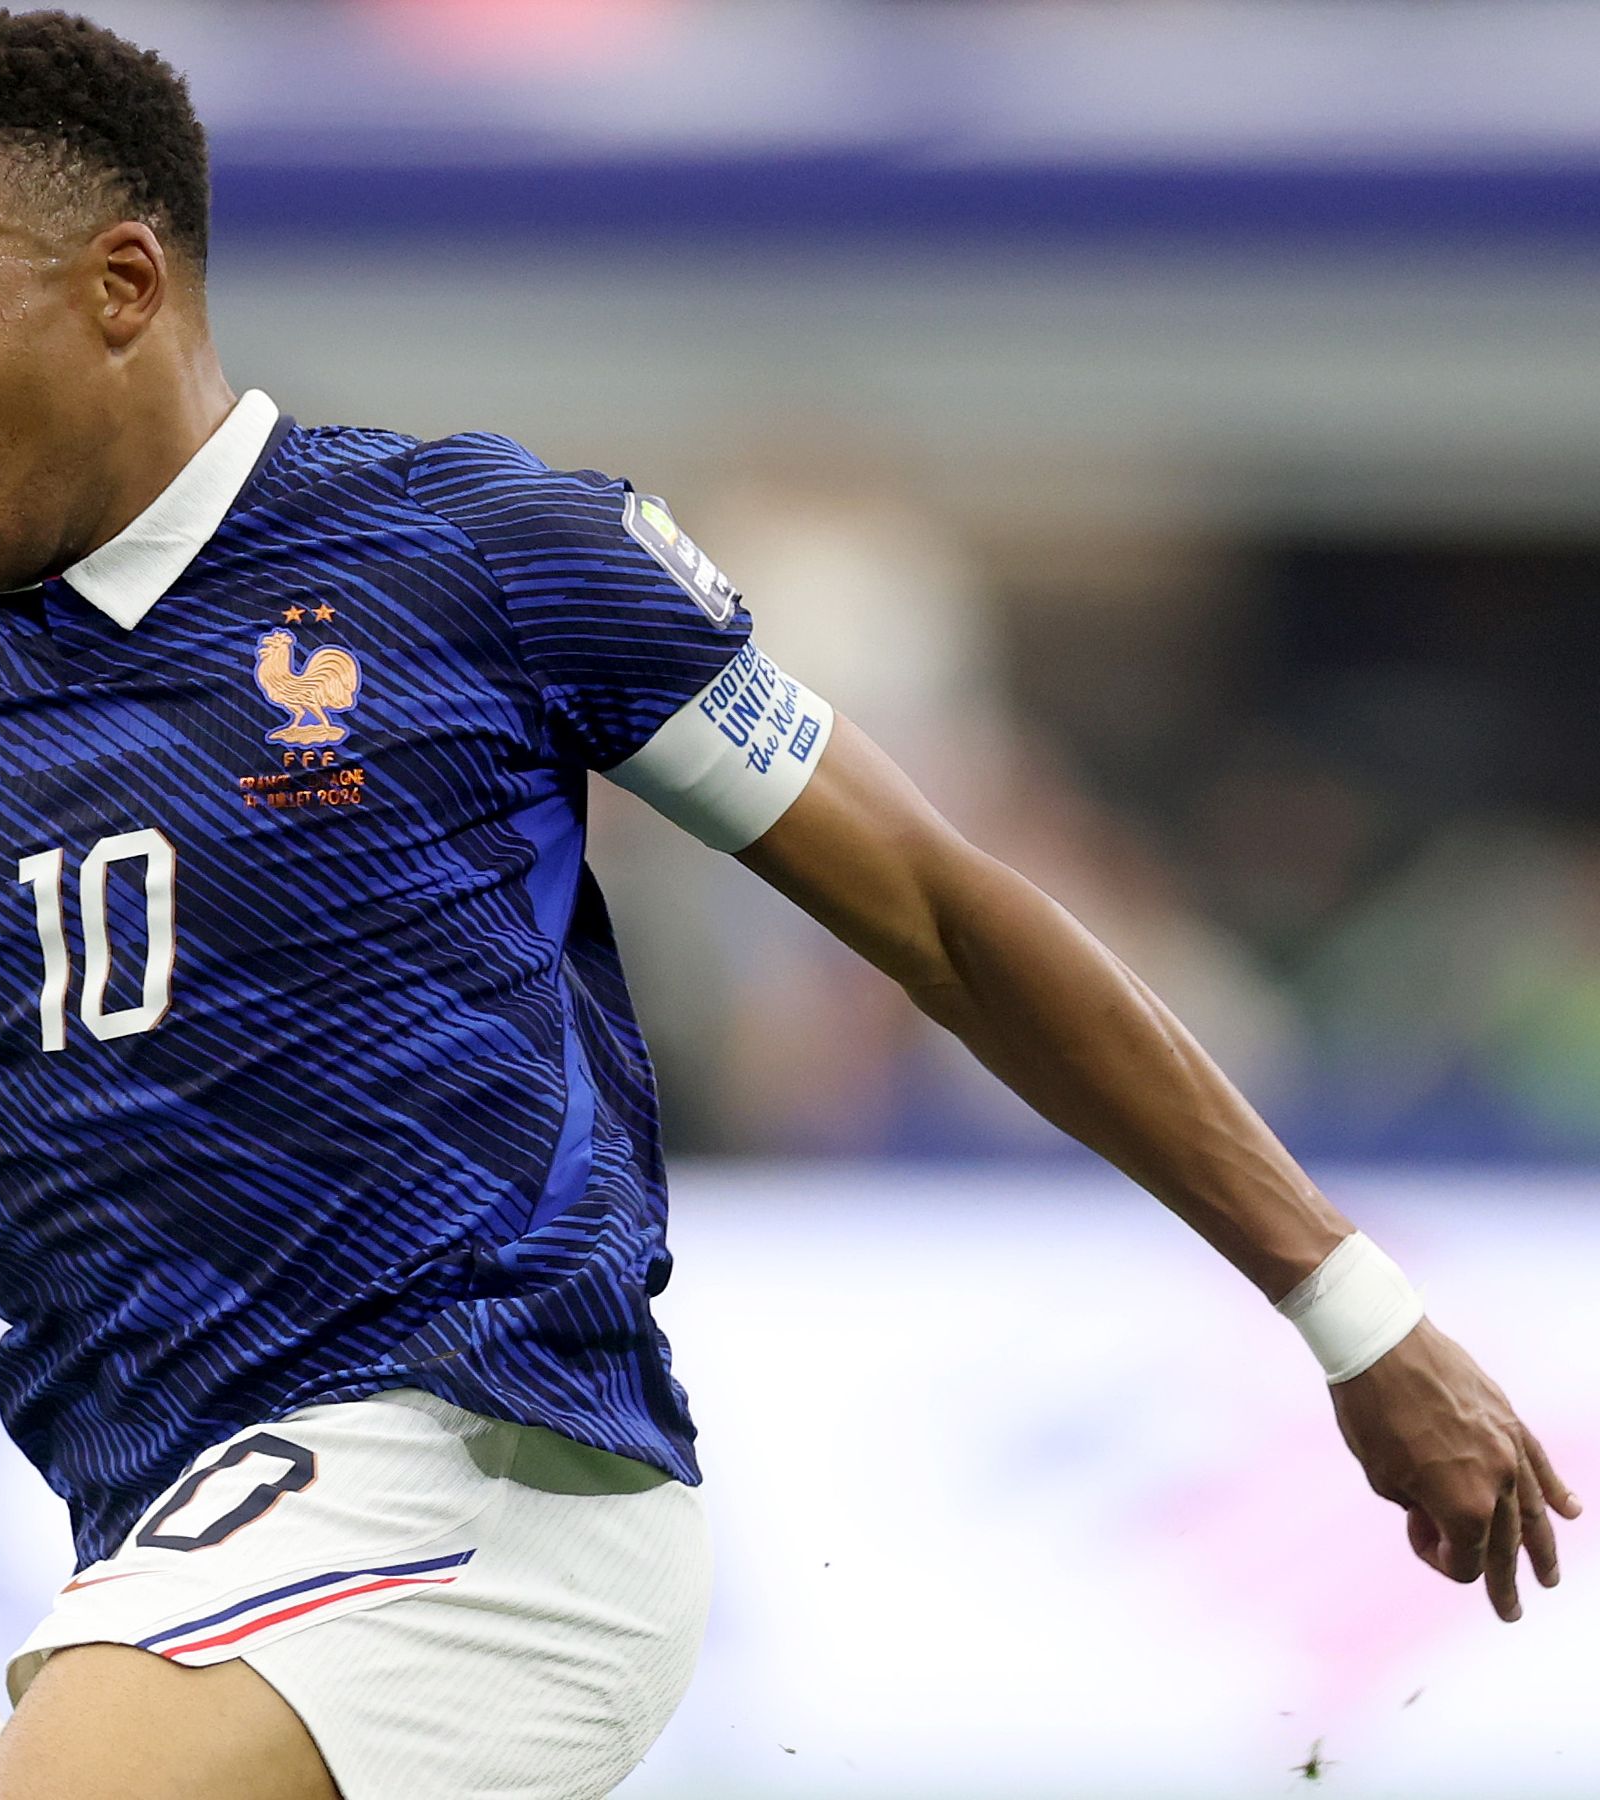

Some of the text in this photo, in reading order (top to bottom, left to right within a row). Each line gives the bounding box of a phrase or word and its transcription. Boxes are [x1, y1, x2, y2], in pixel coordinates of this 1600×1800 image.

[699, 641, 757, 724] FOOTBA
[745, 735, 779, 775] the
[791, 719, 818, 761] FIFA
[18, 827, 177, 1053] 10
